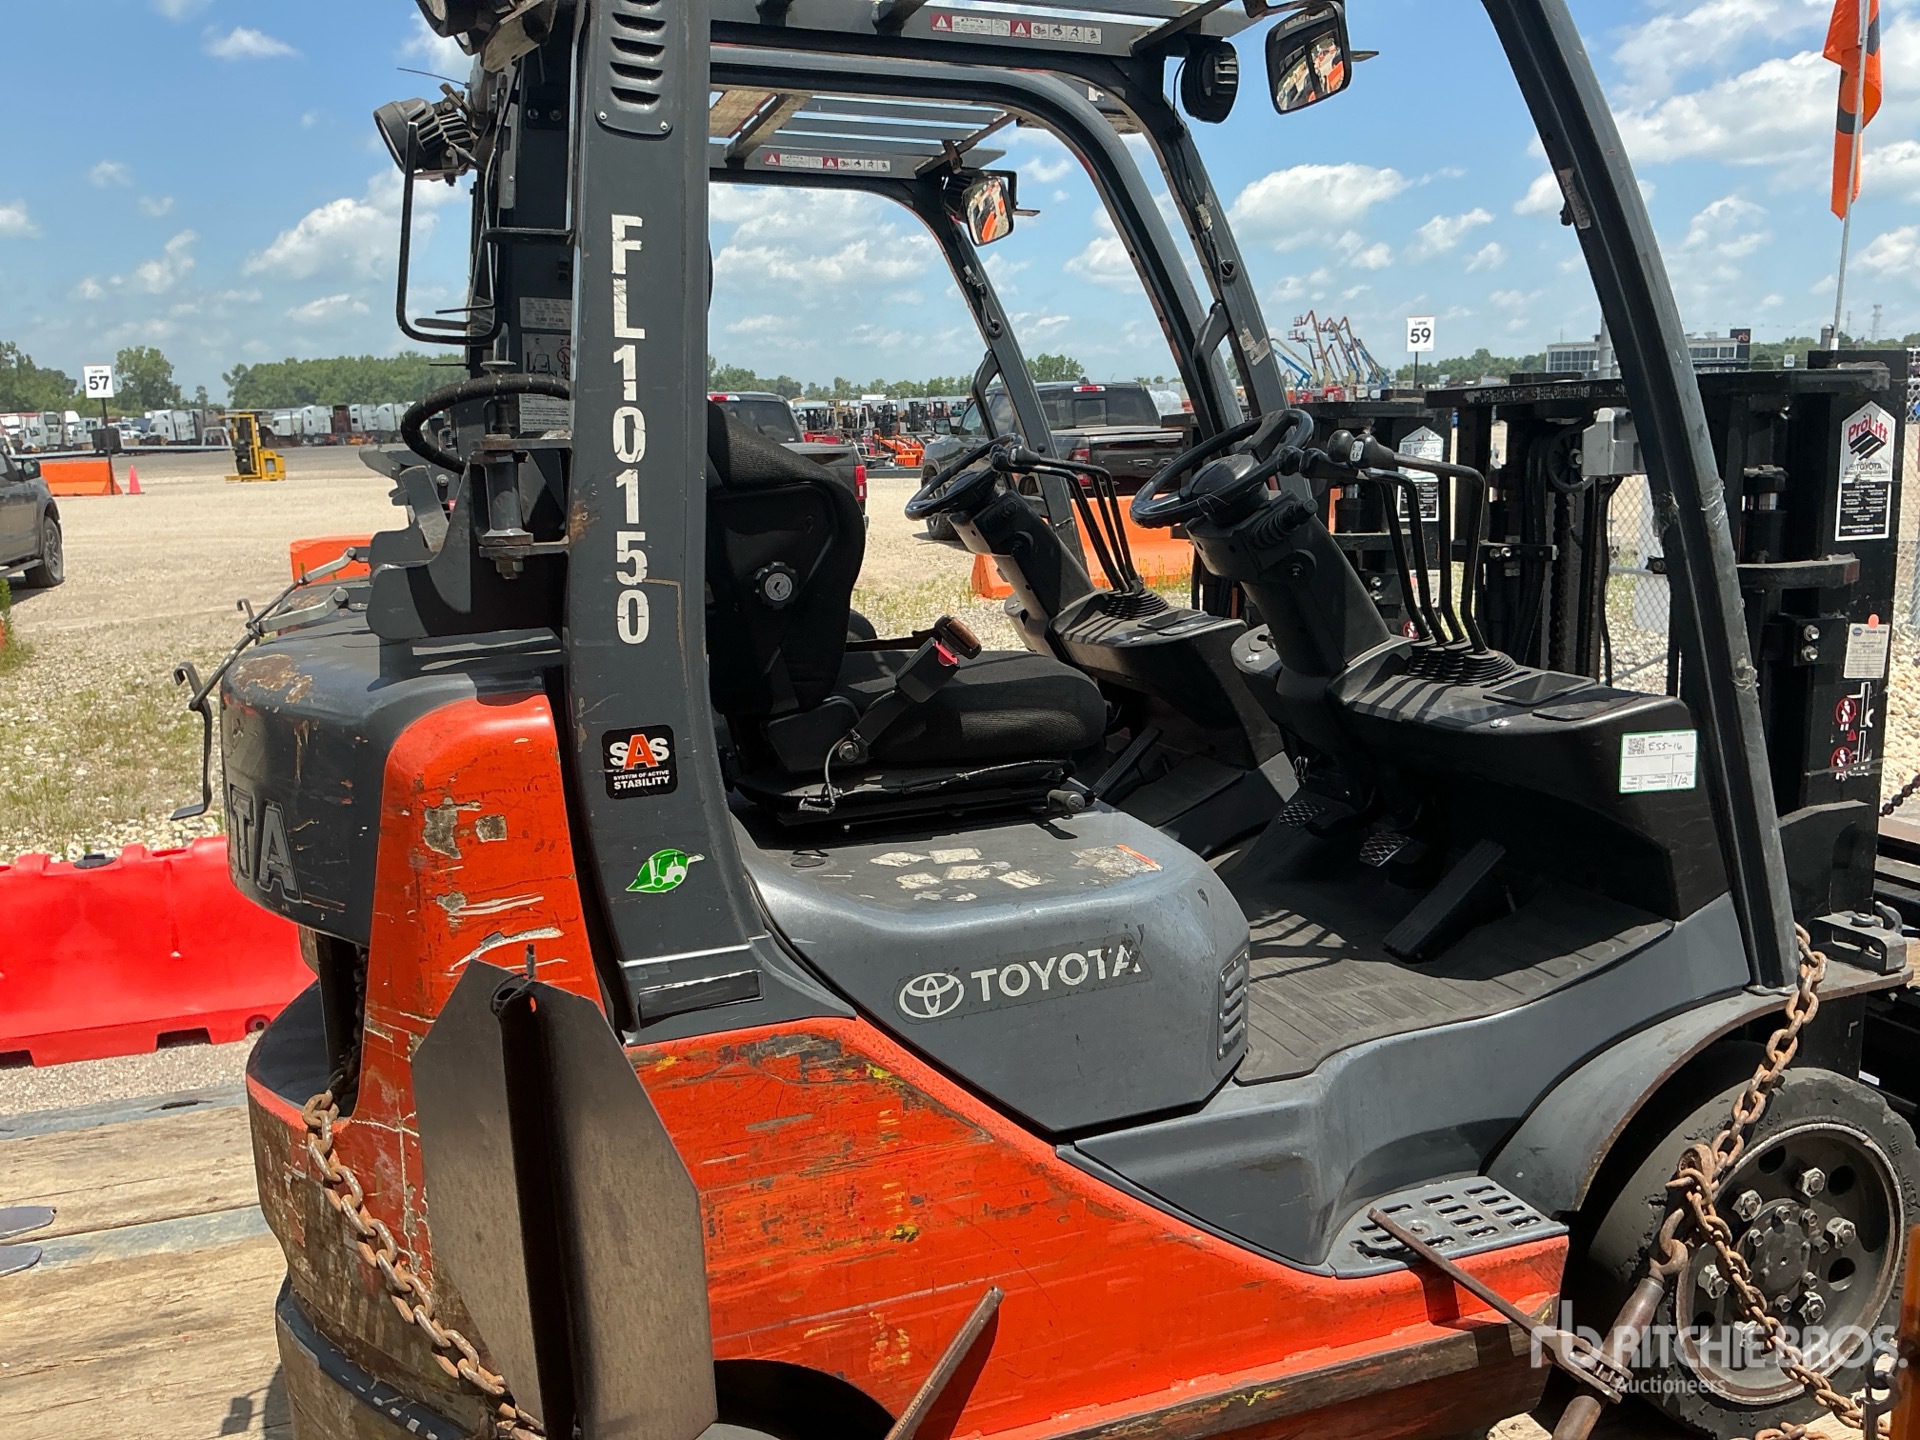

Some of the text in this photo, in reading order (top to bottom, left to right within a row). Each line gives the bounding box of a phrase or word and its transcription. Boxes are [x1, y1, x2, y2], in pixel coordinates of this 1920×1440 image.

[1410, 327, 1431, 344] 59
[89, 375, 109, 390] 57
[611, 213, 650, 645] FL10150
[1855, 462, 1882, 471] TOYOTA
[609, 734, 670, 770] SAS
[613, 773, 638, 781] SYSTEM
[613, 775, 670, 790] STABILITY
[970, 944, 1142, 1002] TOYOTA
